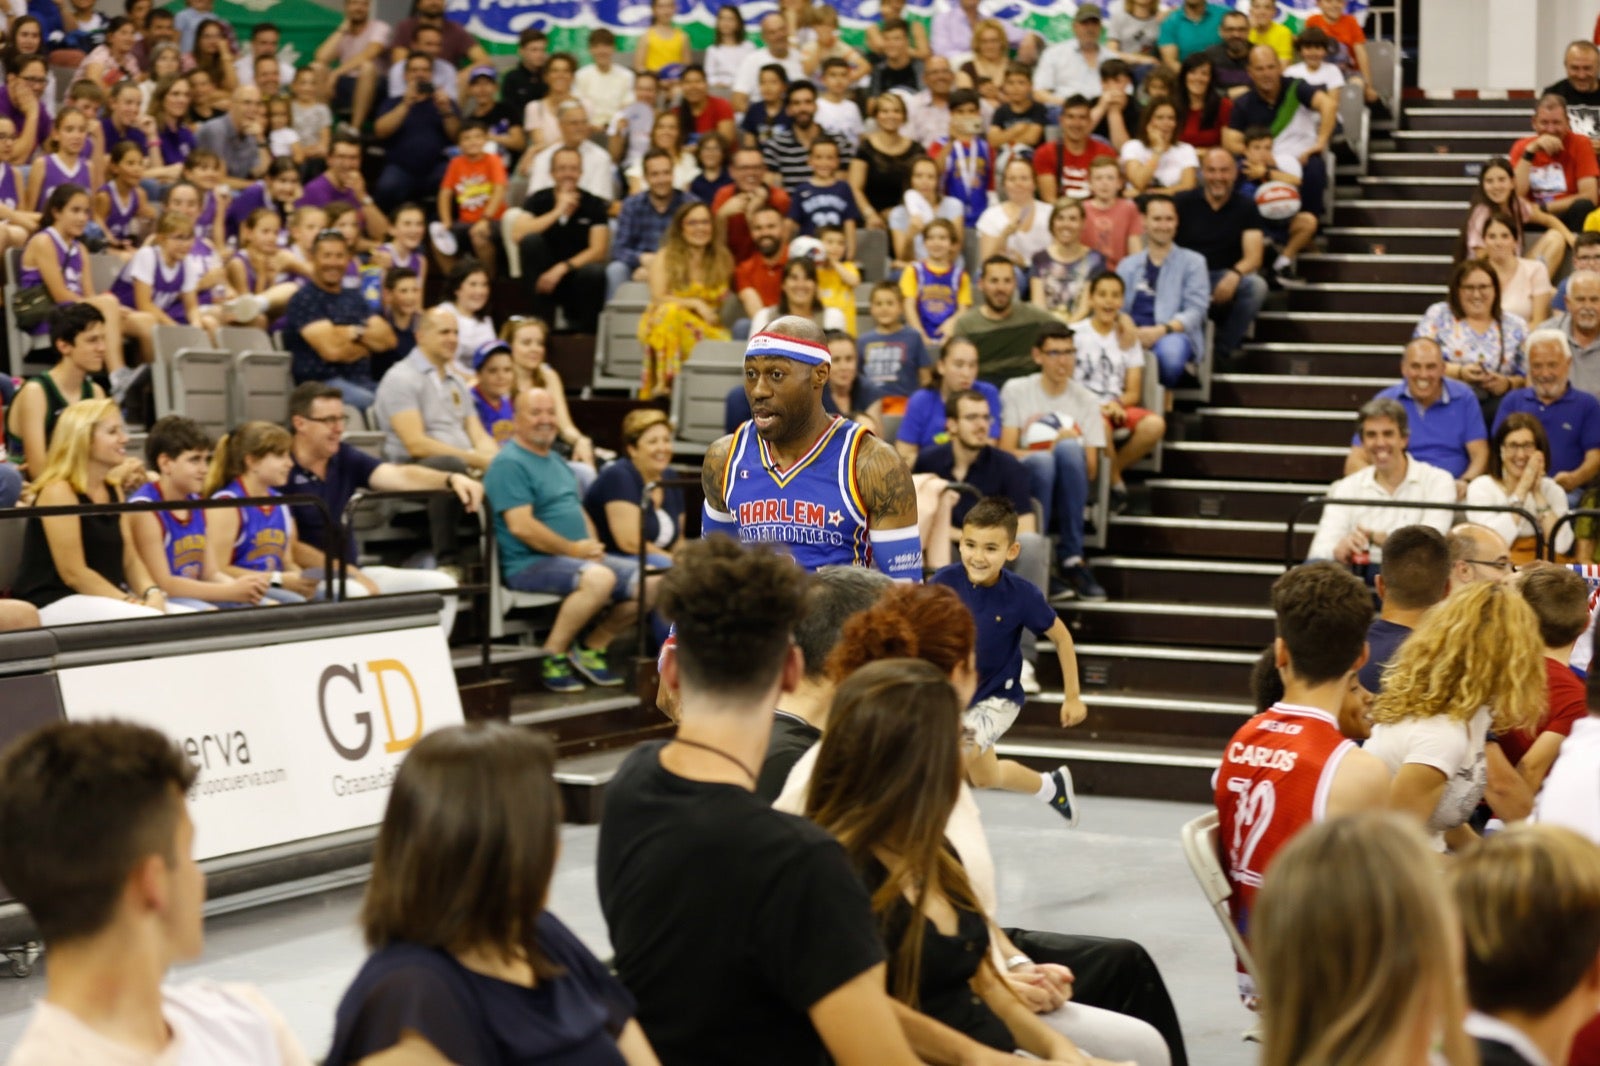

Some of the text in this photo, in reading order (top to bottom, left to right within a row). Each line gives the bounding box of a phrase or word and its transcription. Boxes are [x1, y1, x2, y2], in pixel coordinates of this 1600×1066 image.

[739, 499, 826, 529] HARLEM
[738, 524, 843, 546] LOBETROTTERS
[177, 730, 251, 769] erva
[1227, 741, 1298, 772] CARLOS
